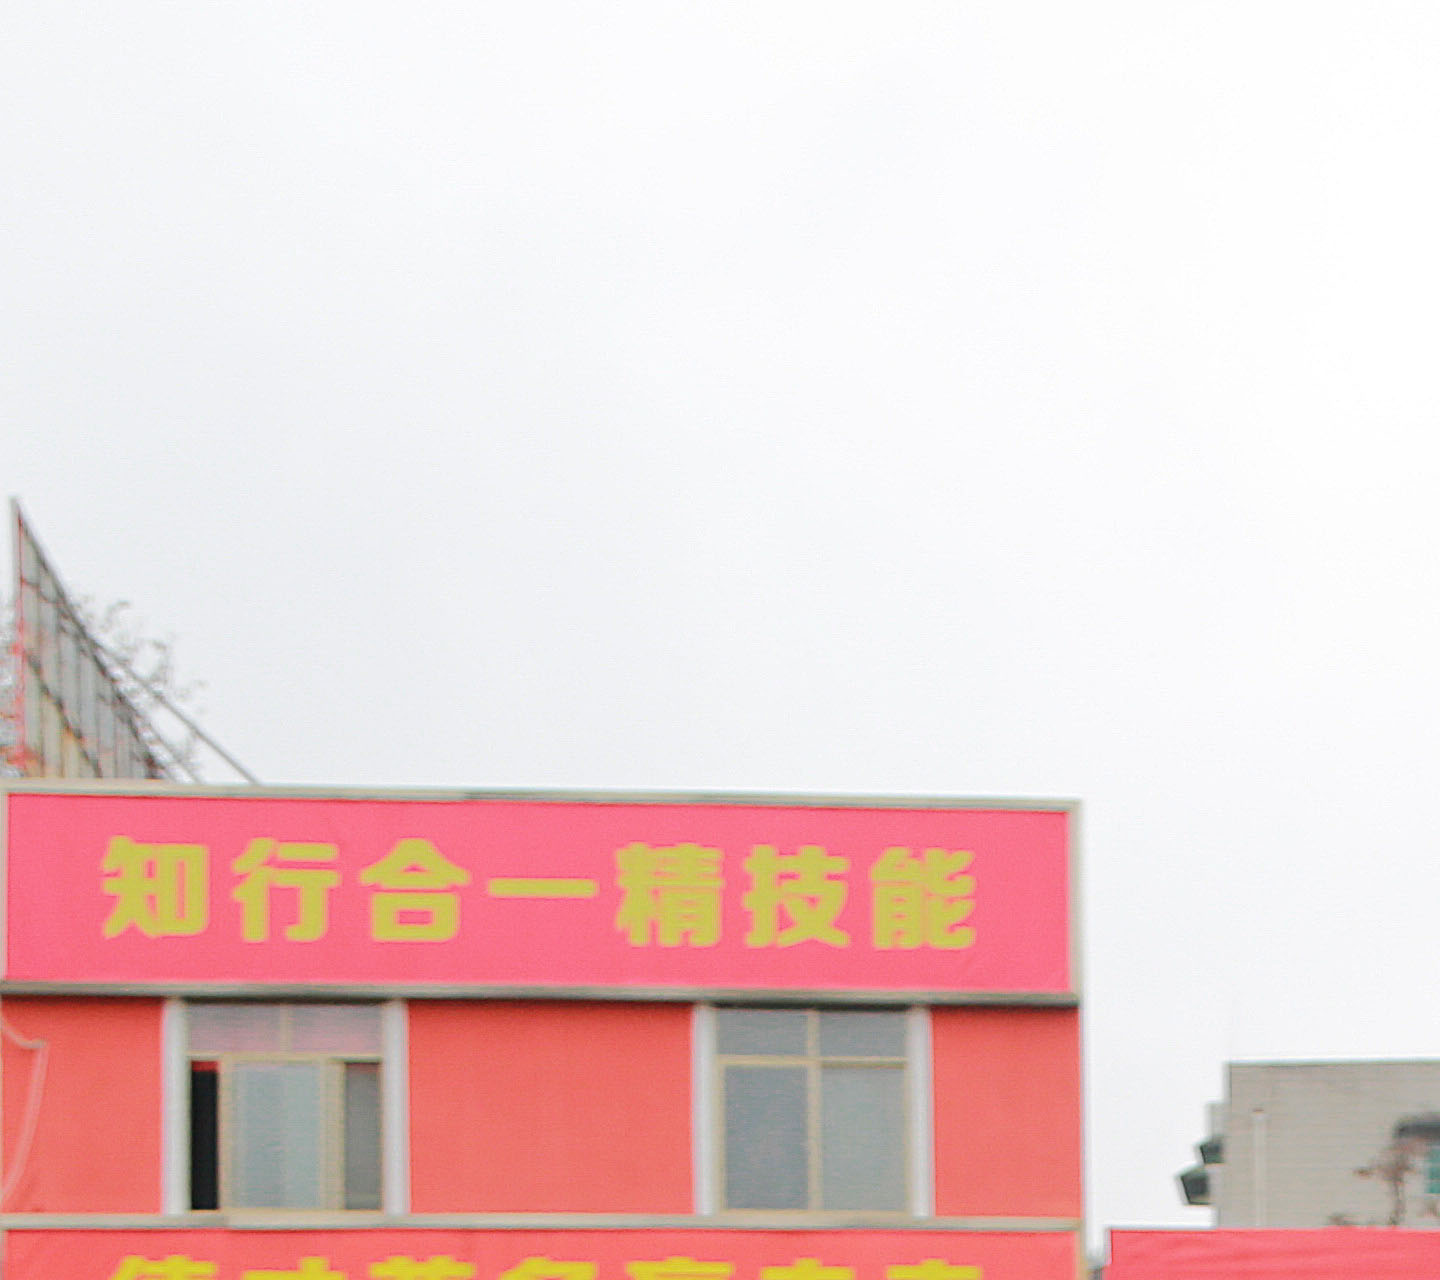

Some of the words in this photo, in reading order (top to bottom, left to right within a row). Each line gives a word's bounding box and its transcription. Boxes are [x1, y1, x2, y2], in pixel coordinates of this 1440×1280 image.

[101, 836, 977, 950] 知行合一精技能
